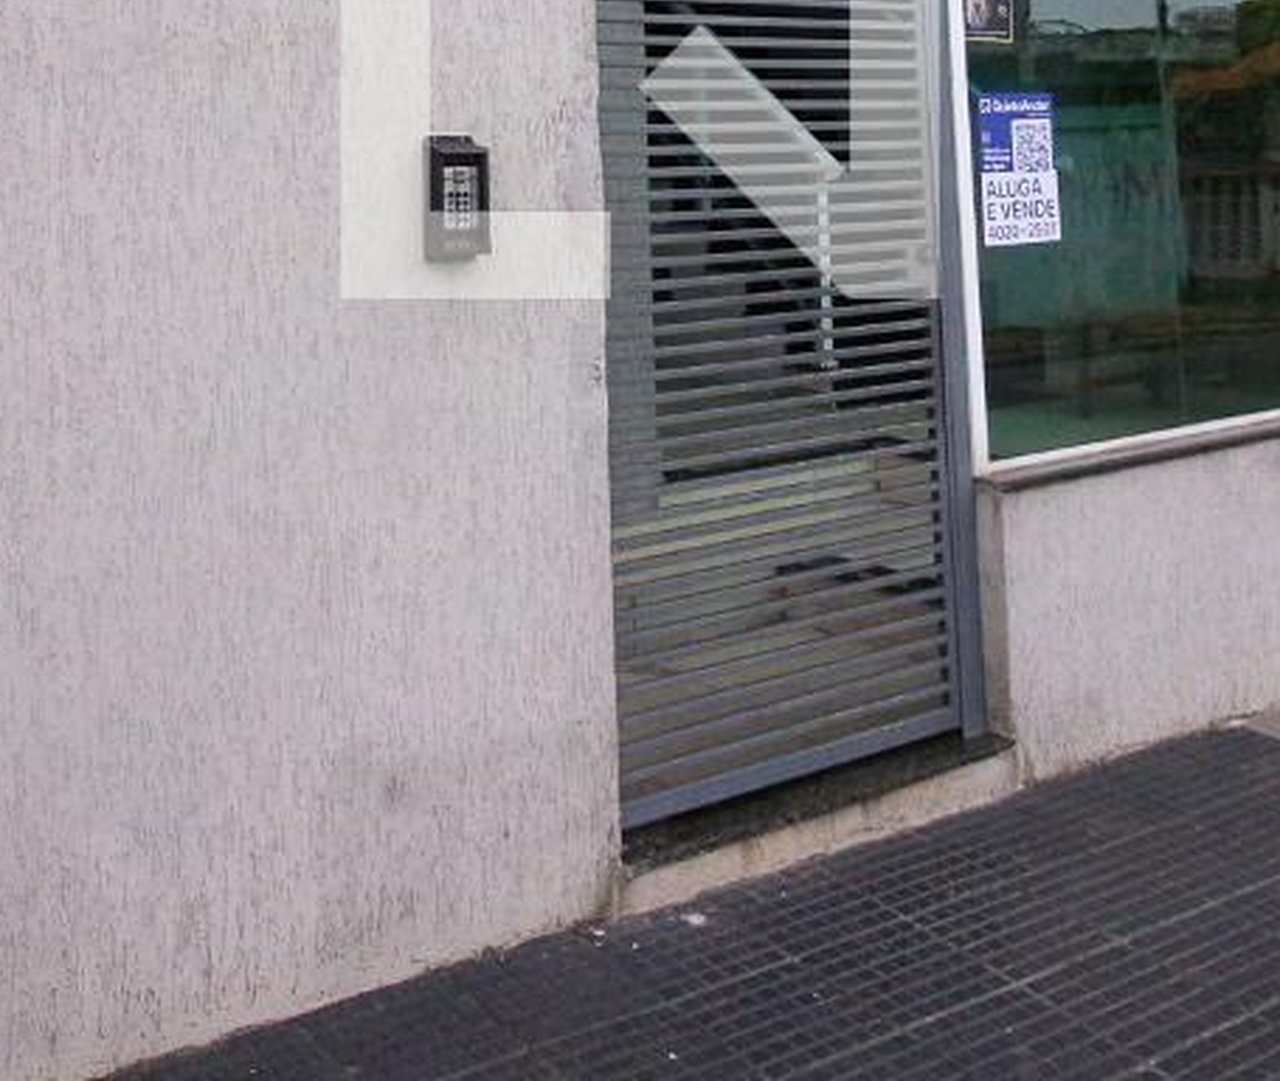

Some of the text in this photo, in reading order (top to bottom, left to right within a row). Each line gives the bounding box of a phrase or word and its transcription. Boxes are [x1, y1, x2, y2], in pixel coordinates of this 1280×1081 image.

[987, 178, 1042, 198] ALUGA
[987, 199, 1056, 221] E VENDE
